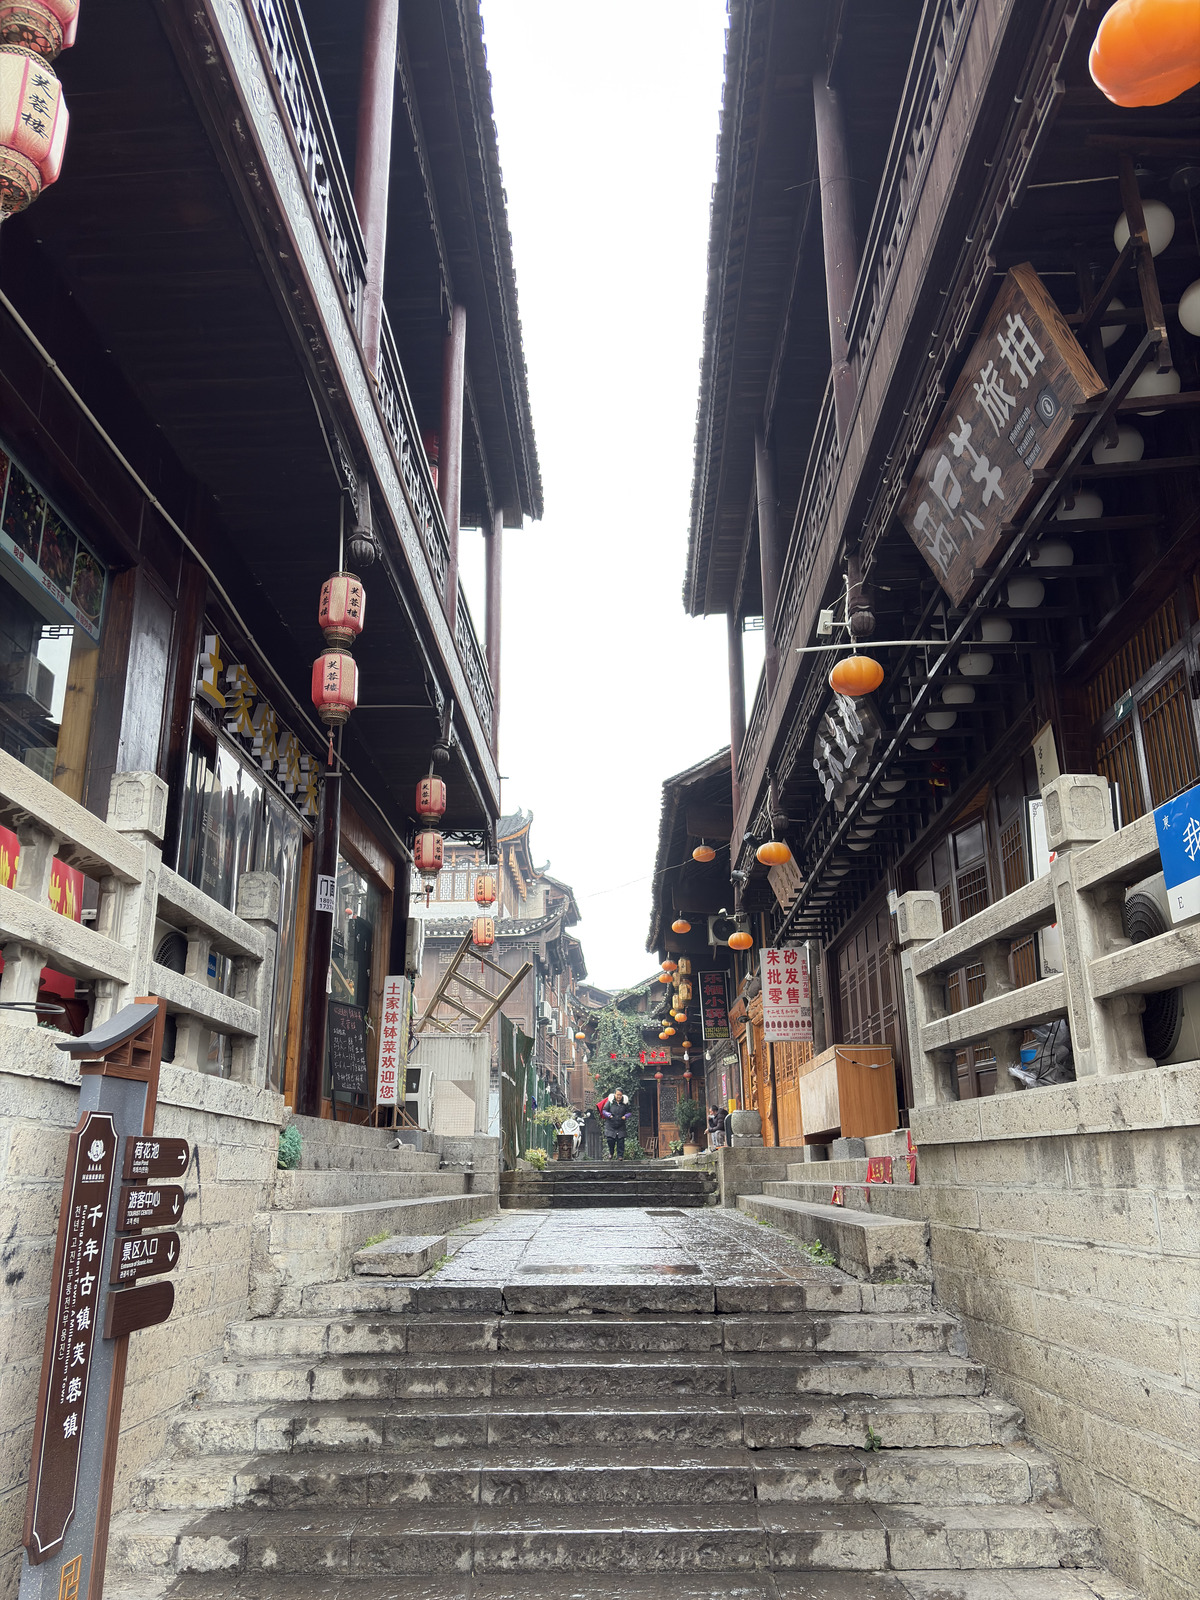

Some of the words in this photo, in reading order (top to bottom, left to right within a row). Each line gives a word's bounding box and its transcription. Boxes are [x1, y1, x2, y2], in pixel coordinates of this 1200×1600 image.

[21, 73, 55, 140] 芙蓉楼
[346, 586, 360, 619] 芙蓉楼
[324, 660, 340, 692] 芙蓉楼
[197, 635, 320, 816] 土家钵钵菜
[1162, 814, 1171, 831] 東
[1177, 895, 1185, 910] E
[766, 949, 798, 966] 朱砂
[767, 968, 800, 985] 批发
[768, 987, 800, 1004] 零售
[379, 982, 400, 1099] 土家钵钵菜欢迎您
[134, 1141, 160, 1159] 荷花池
[127, 1209, 141, 1217] TOURIST
[128, 1190, 161, 1209] 游客中心
[79, 1204, 88, 1237] Furong
[75, 1239, 84, 1277] Ancient
[121, 1238, 159, 1261] 景区入口
[63, 1203, 103, 1439] 千年古镇芙蓉镇
[63, 1319, 75, 1375] Millennium
[60, 1375, 68, 1405] Town
